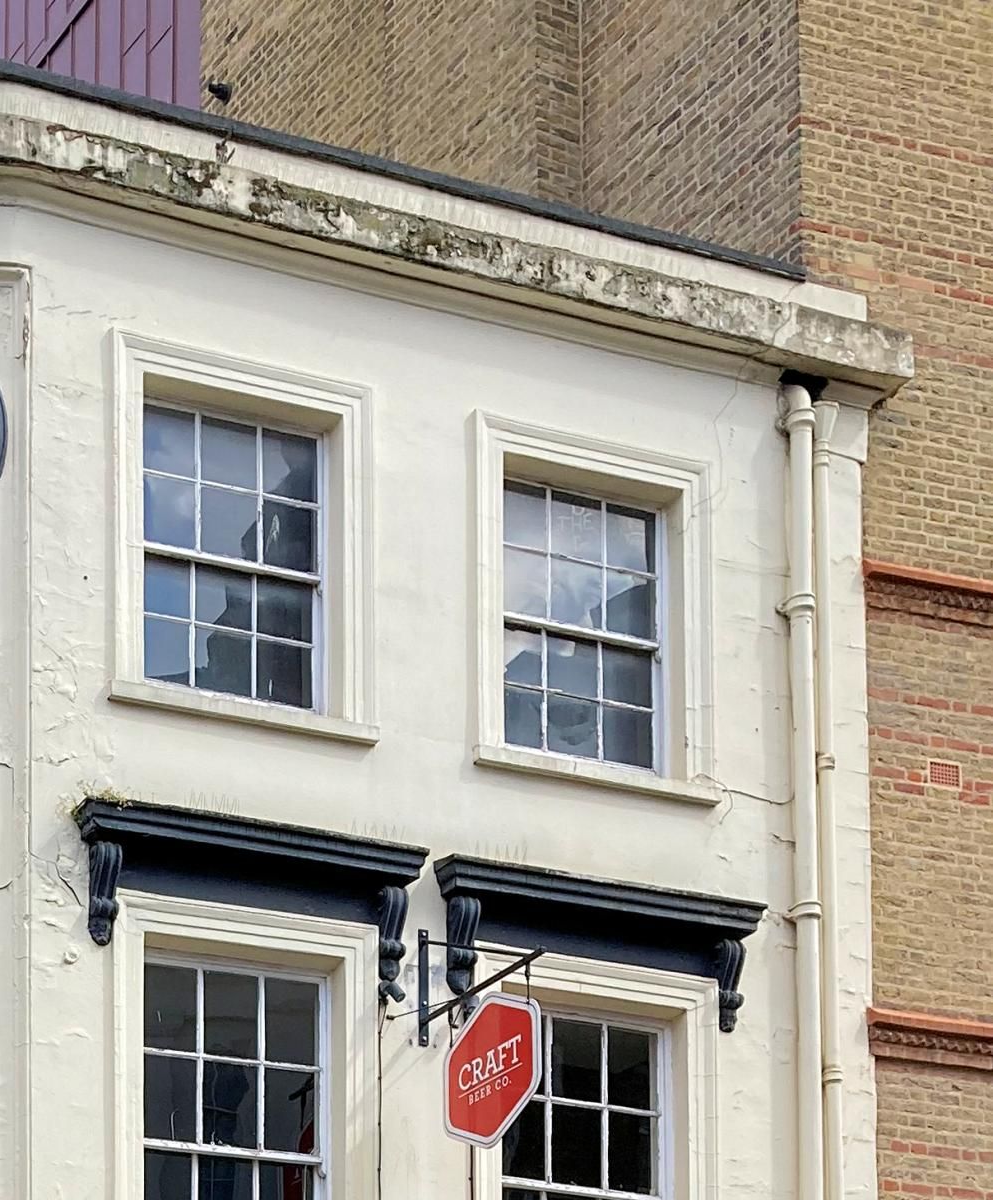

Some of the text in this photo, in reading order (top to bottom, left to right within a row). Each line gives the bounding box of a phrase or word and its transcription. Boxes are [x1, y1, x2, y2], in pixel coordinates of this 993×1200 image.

[458, 1033, 522, 1091] CRAFT
[468, 1075, 512, 1106] BEER CO.
